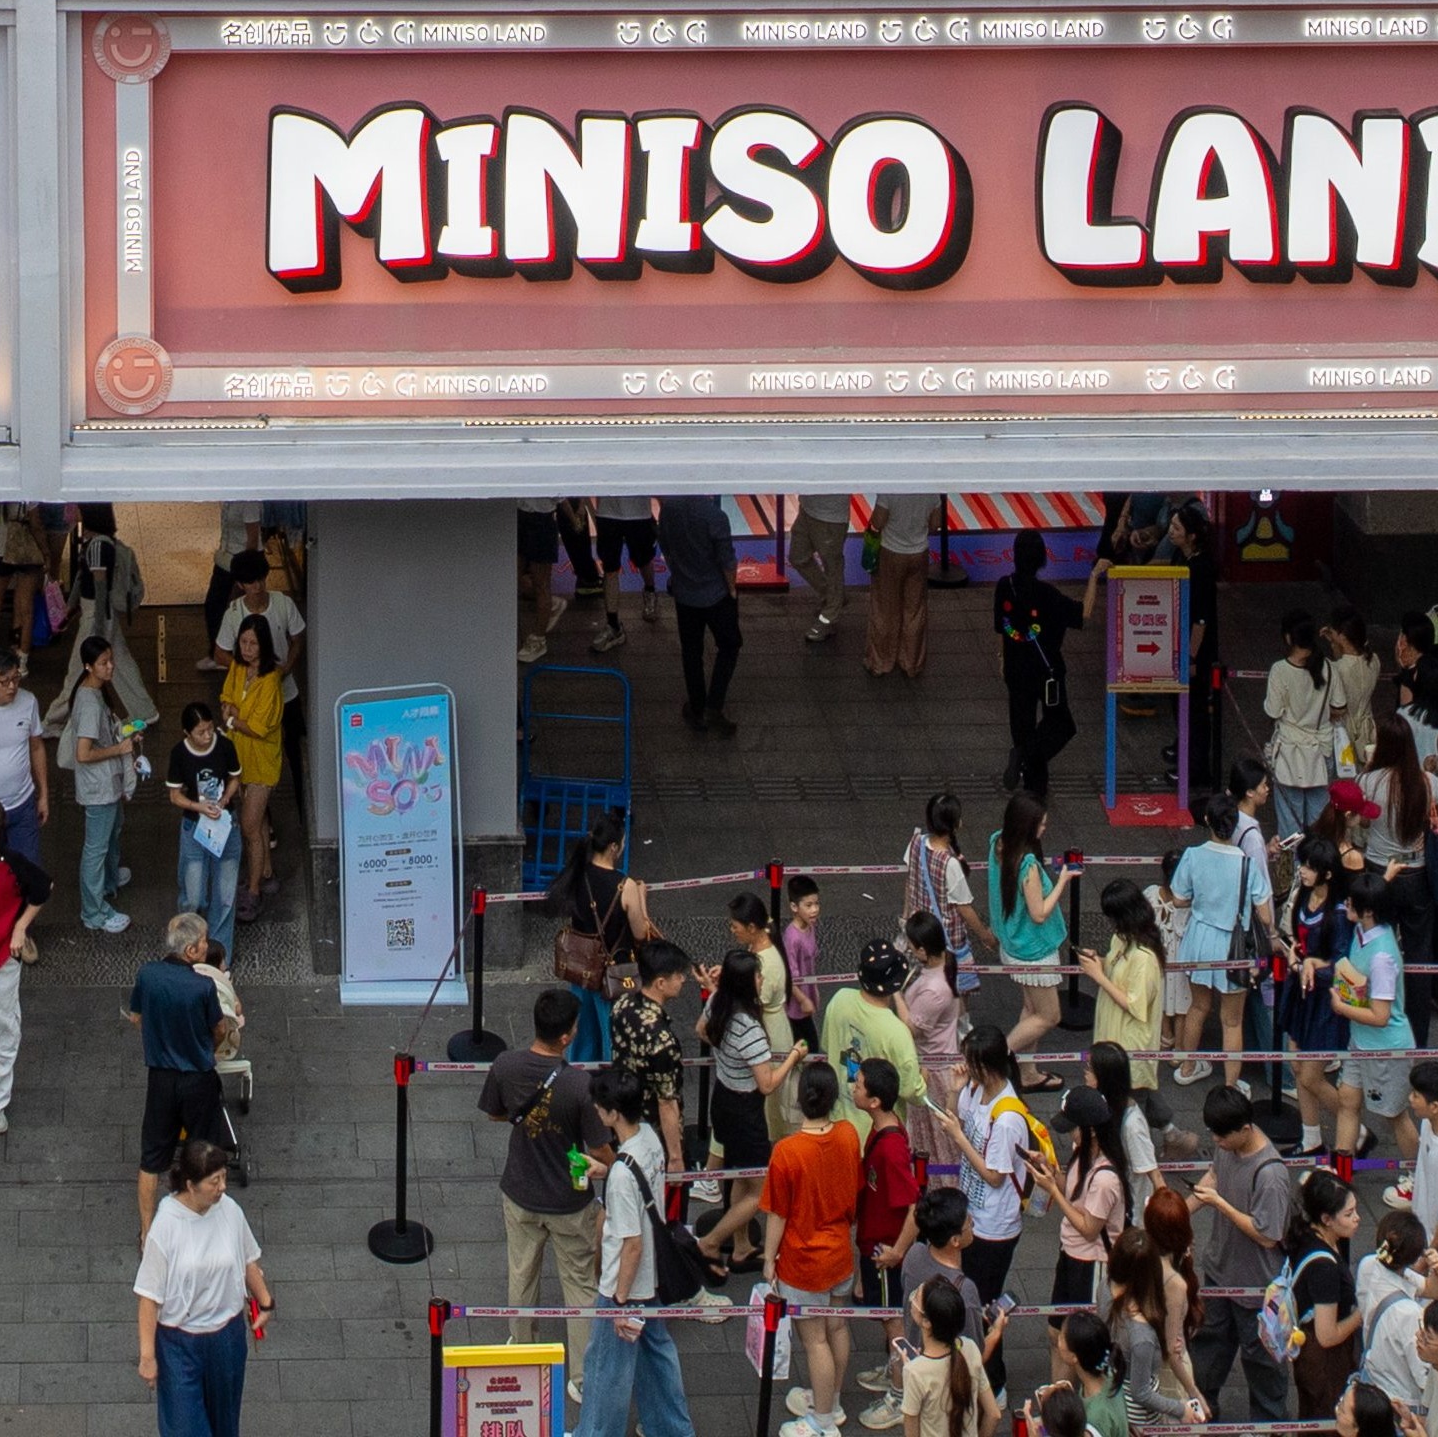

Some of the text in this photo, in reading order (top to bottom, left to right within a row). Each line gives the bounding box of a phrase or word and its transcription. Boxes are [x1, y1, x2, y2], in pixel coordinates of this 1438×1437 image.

[221, 20, 312, 47] 名创优品
[421, 21, 546, 44] MINISO LAND
[980, 18, 1104, 40] MINISO LAND
[268, 99, 974, 294] MINISO
[125, 149, 141, 273] MINISO LAND
[225, 373, 314, 399] 名创优品
